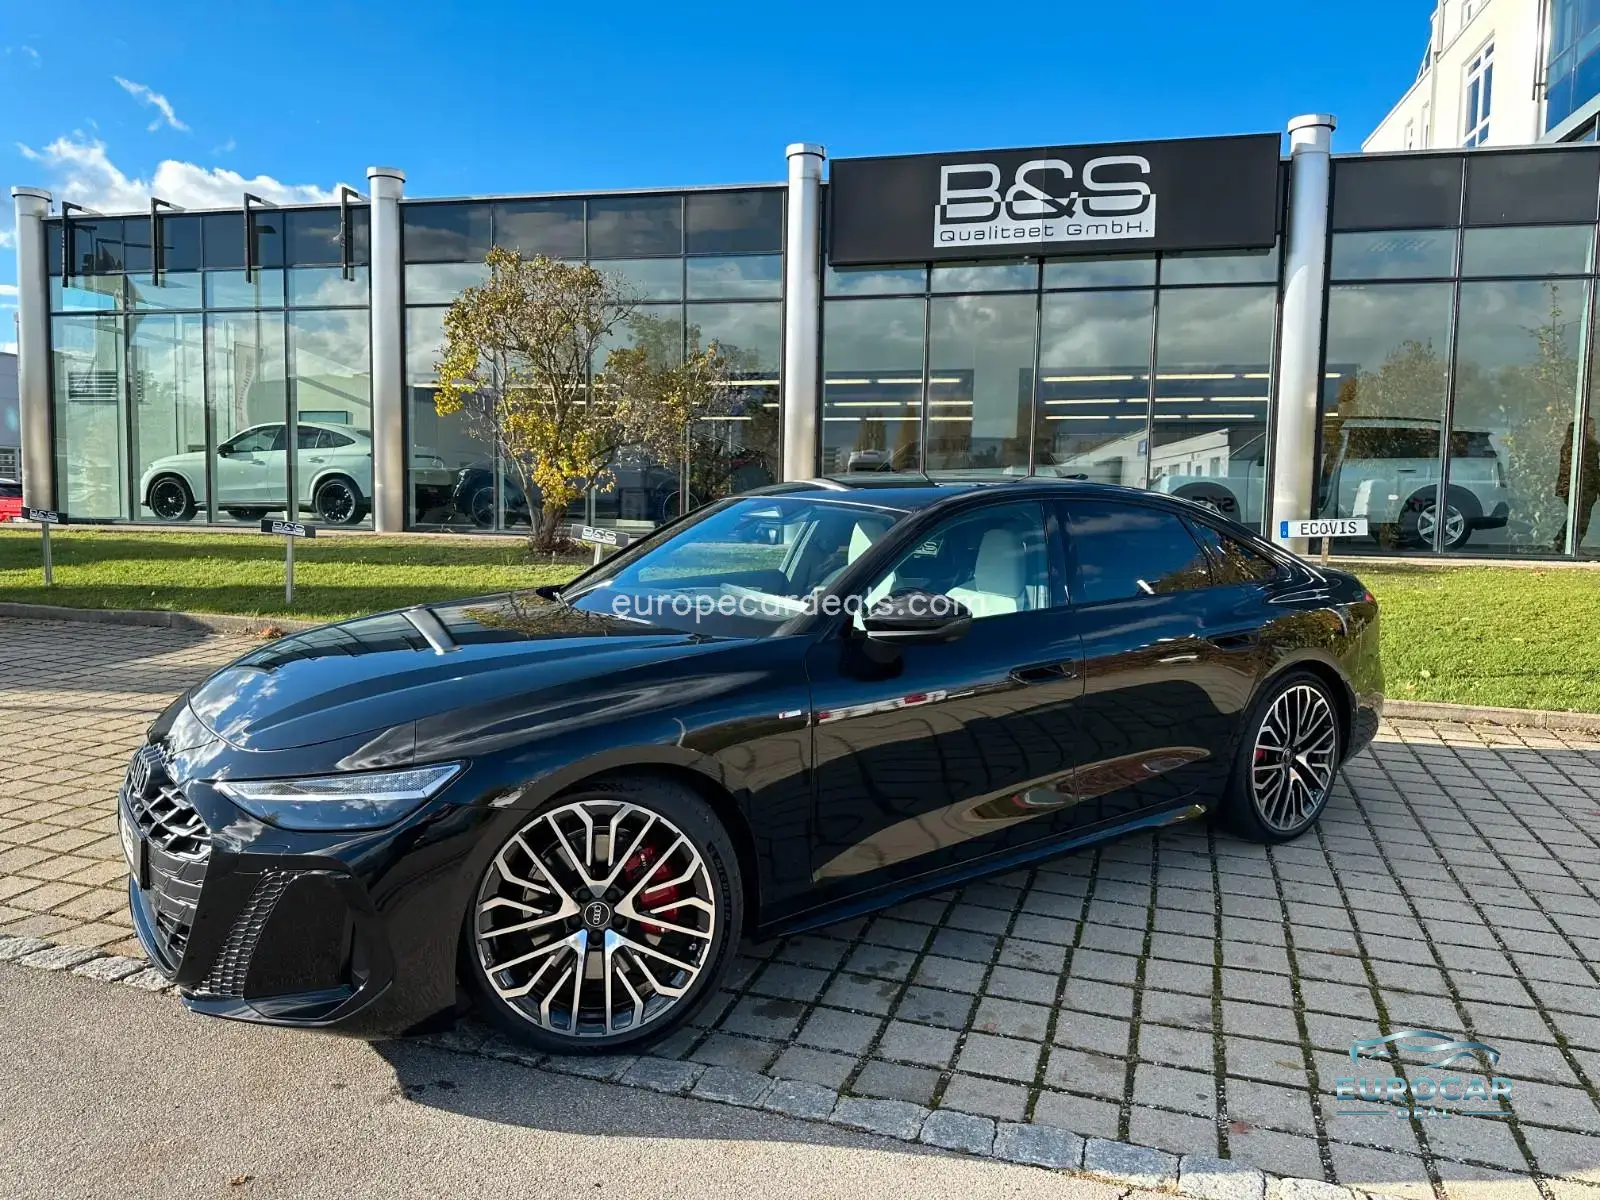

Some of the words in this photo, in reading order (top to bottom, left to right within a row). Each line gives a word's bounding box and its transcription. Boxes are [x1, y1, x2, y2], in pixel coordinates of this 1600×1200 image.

[939, 154, 1151, 226] B&S
[939, 223, 1054, 242] Qualitaet
[1066, 220, 1149, 236] GmbH.
[272, 521, 305, 534] B&S
[1300, 521, 1357, 536] ECOVIS
